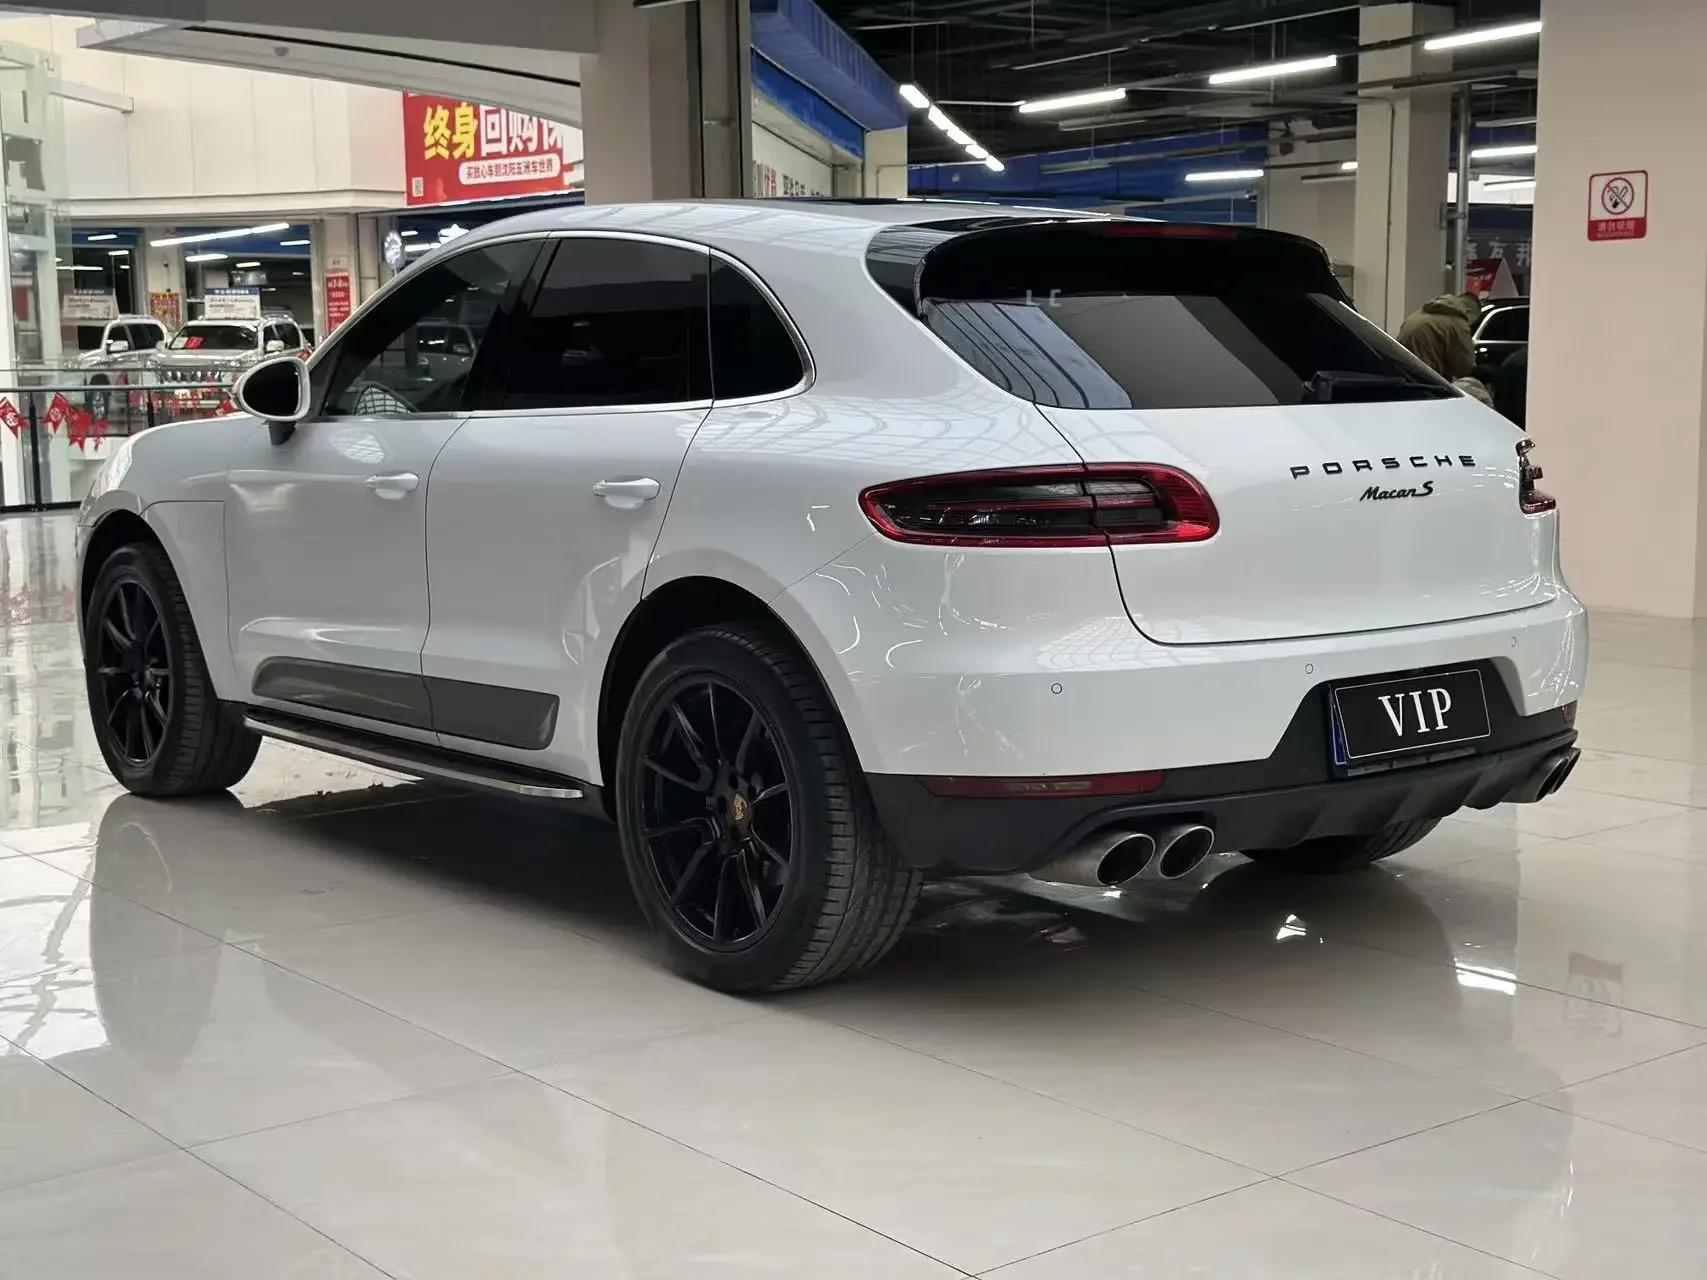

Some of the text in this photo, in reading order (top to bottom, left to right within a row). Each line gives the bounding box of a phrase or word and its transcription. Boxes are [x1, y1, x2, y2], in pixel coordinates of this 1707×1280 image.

[1290, 455, 1476, 479] PORSCHE
[1360, 481, 1434, 501] Macan S
[1378, 688, 1452, 737] VIP
